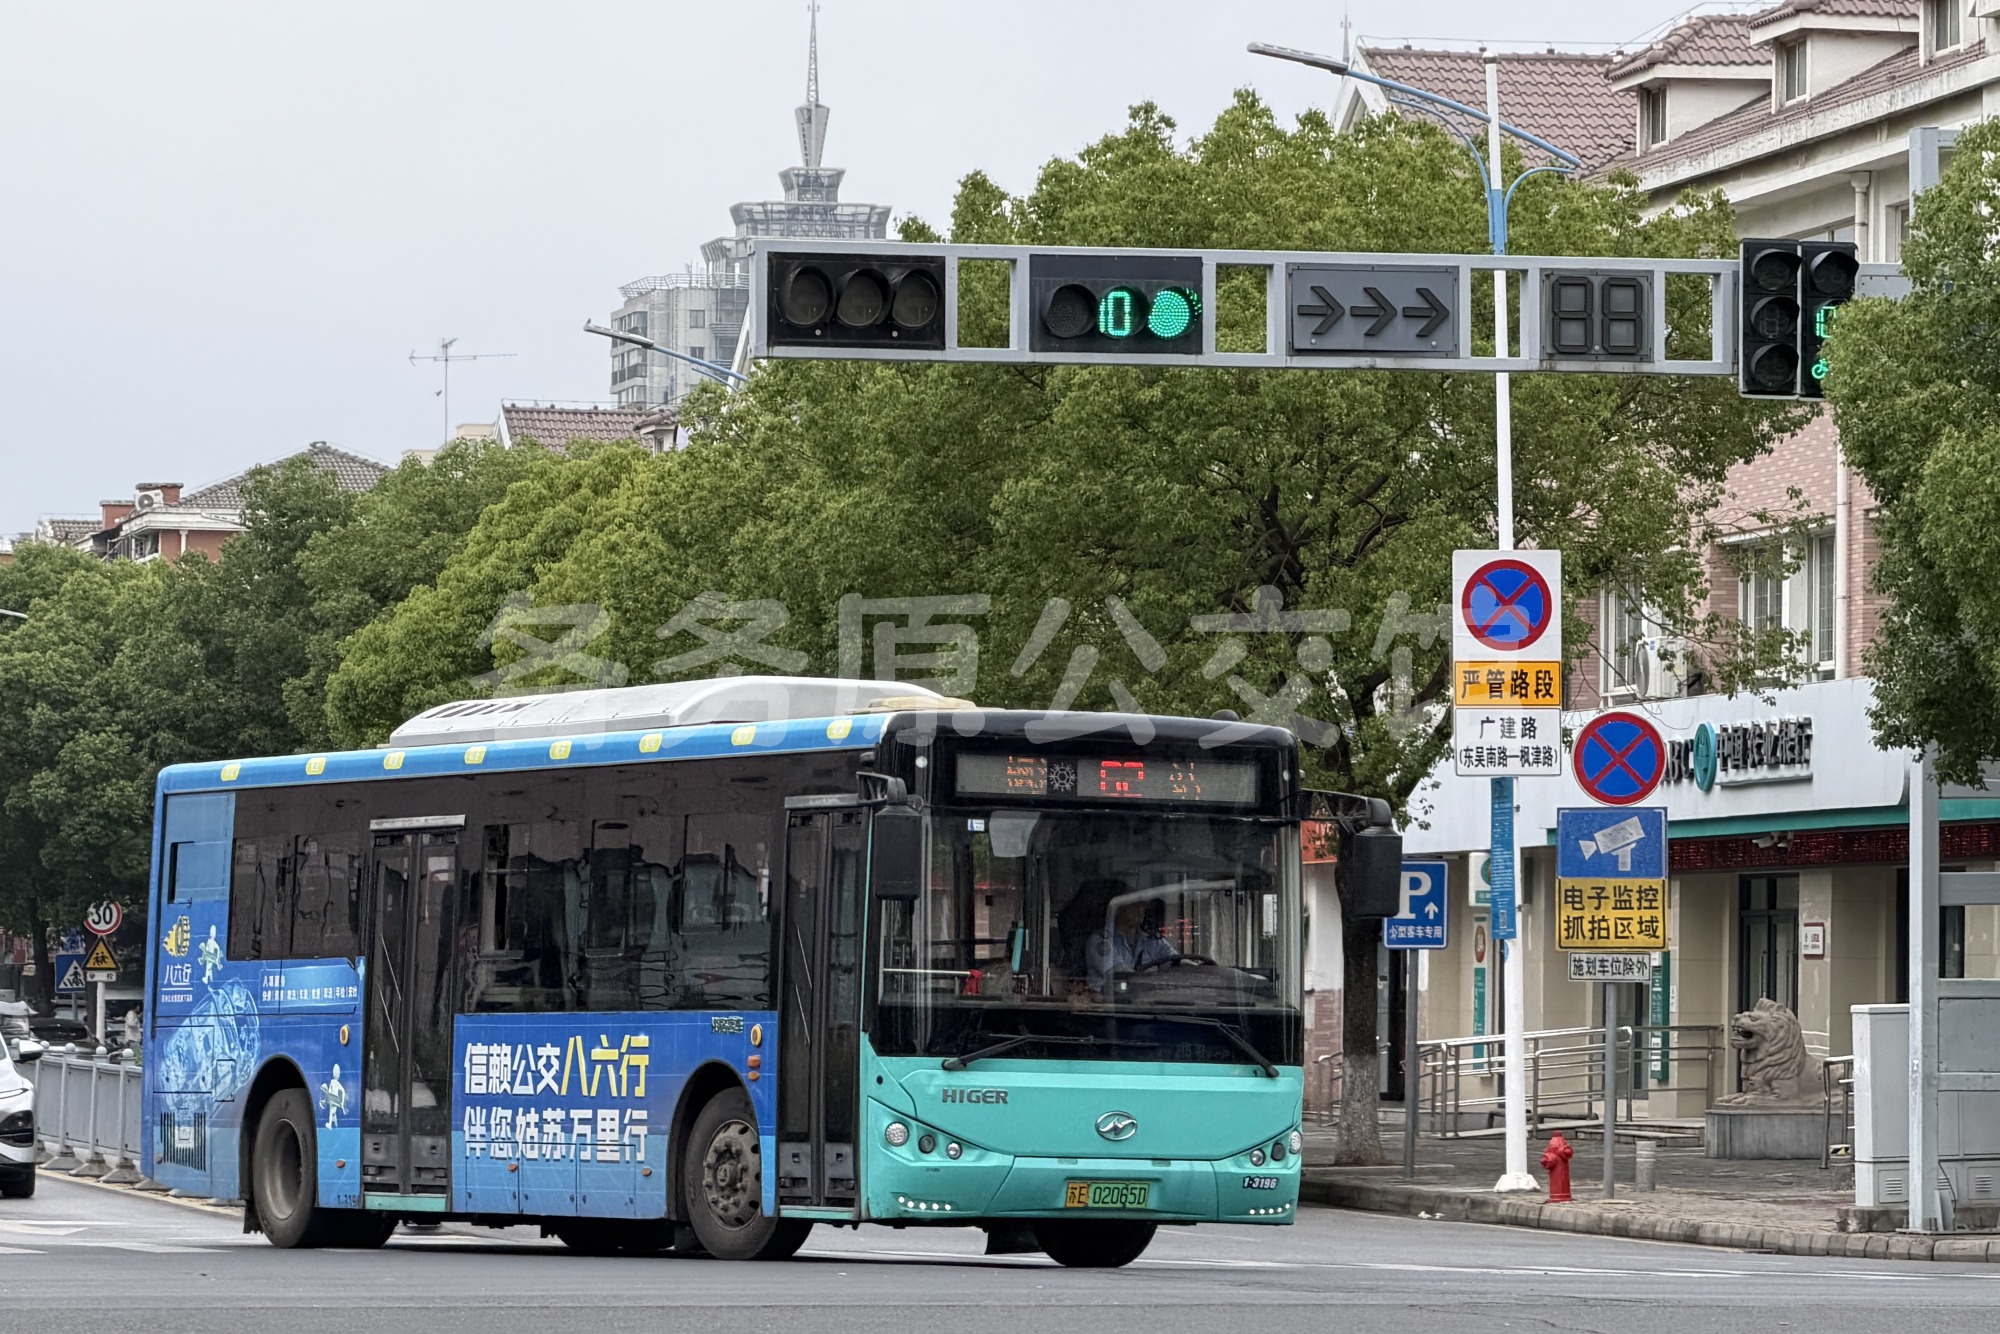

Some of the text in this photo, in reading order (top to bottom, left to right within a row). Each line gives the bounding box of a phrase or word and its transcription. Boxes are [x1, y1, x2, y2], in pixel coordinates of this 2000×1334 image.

[1098, 290, 1132, 337] 10
[1461, 669, 1554, 699] 严管路段
[1479, 716, 1537, 740] 广建路
[1715, 716, 1814, 772] 中国农业银行
[1662, 739, 1694, 782] BC
[1393, 870, 1432, 920] P
[1563, 885, 1660, 911] 电子监控
[1562, 915, 1661, 940] 抓拍区域
[1572, 956, 1648, 977] 施划车位除外
[463, 1034, 650, 1098] 信赖公交八六行
[942, 1088, 1009, 1105] HIGER
[463, 1106, 649, 1164] 伴您姑苏万里行
